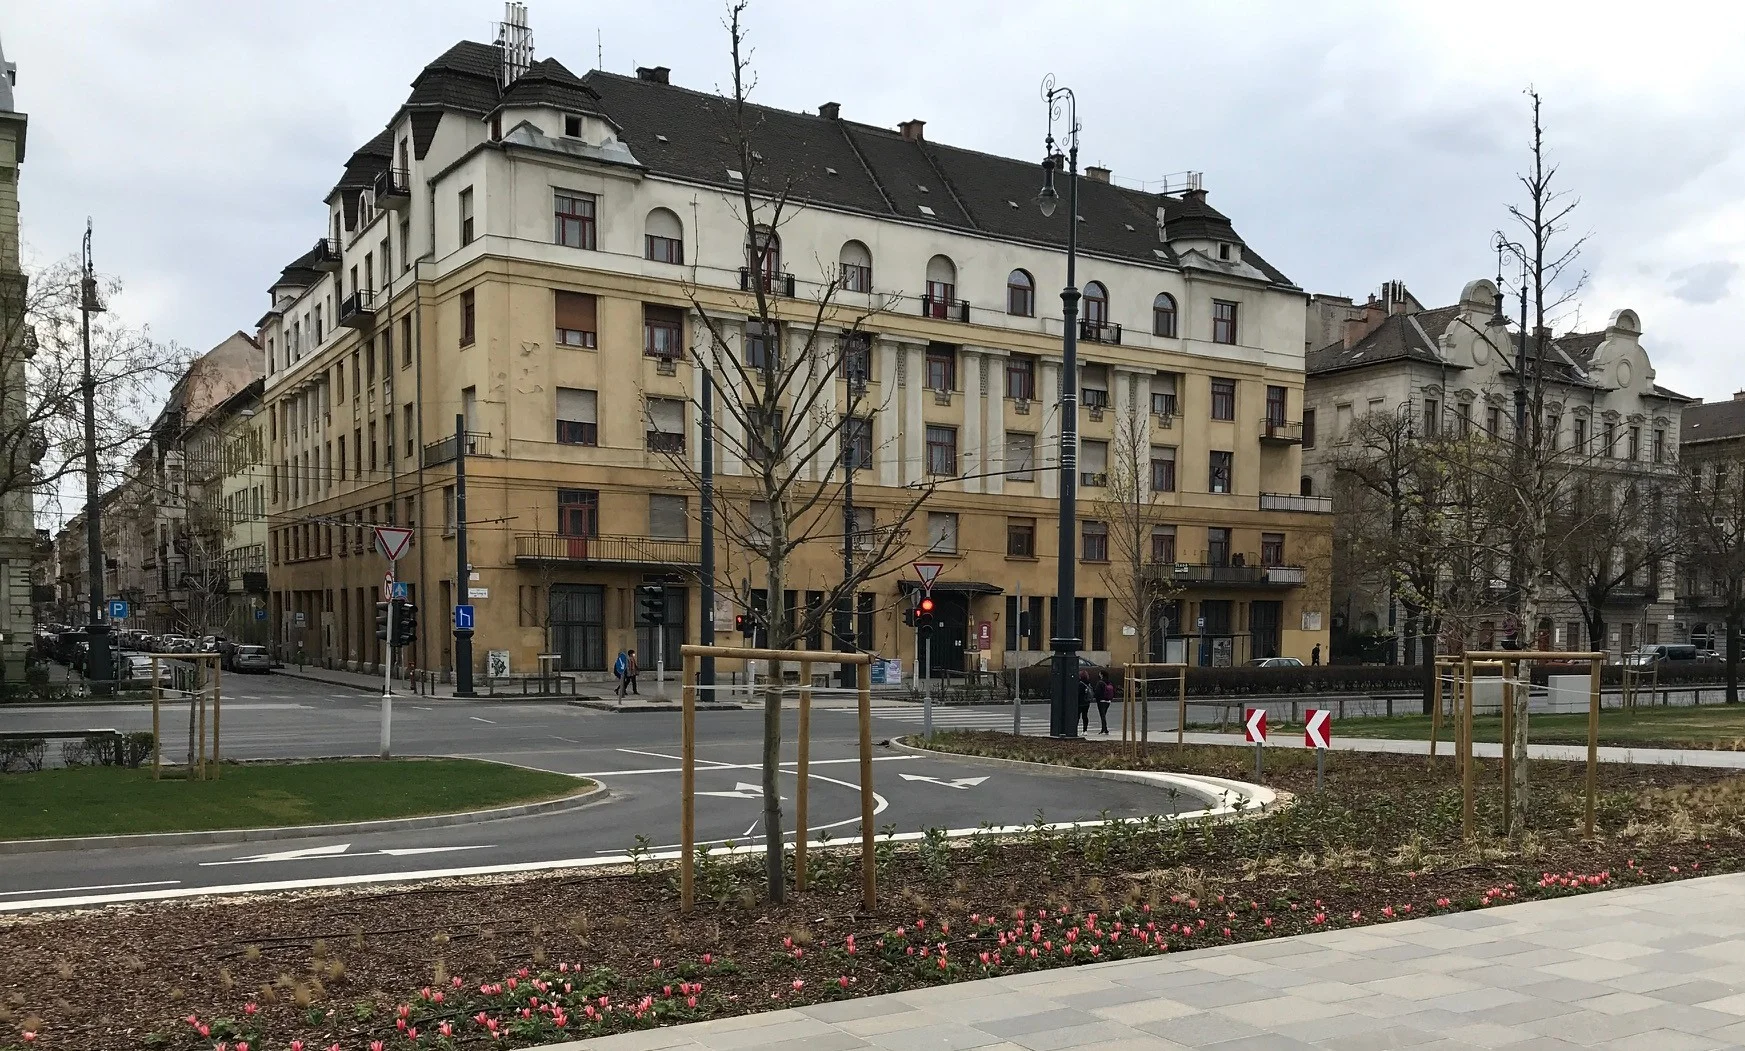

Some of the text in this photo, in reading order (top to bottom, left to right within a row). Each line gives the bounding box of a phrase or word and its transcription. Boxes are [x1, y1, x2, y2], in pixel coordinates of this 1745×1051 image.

[114, 603, 123, 615] P
[257, 610, 264, 619] P
[993, 612, 1000, 621] 7
